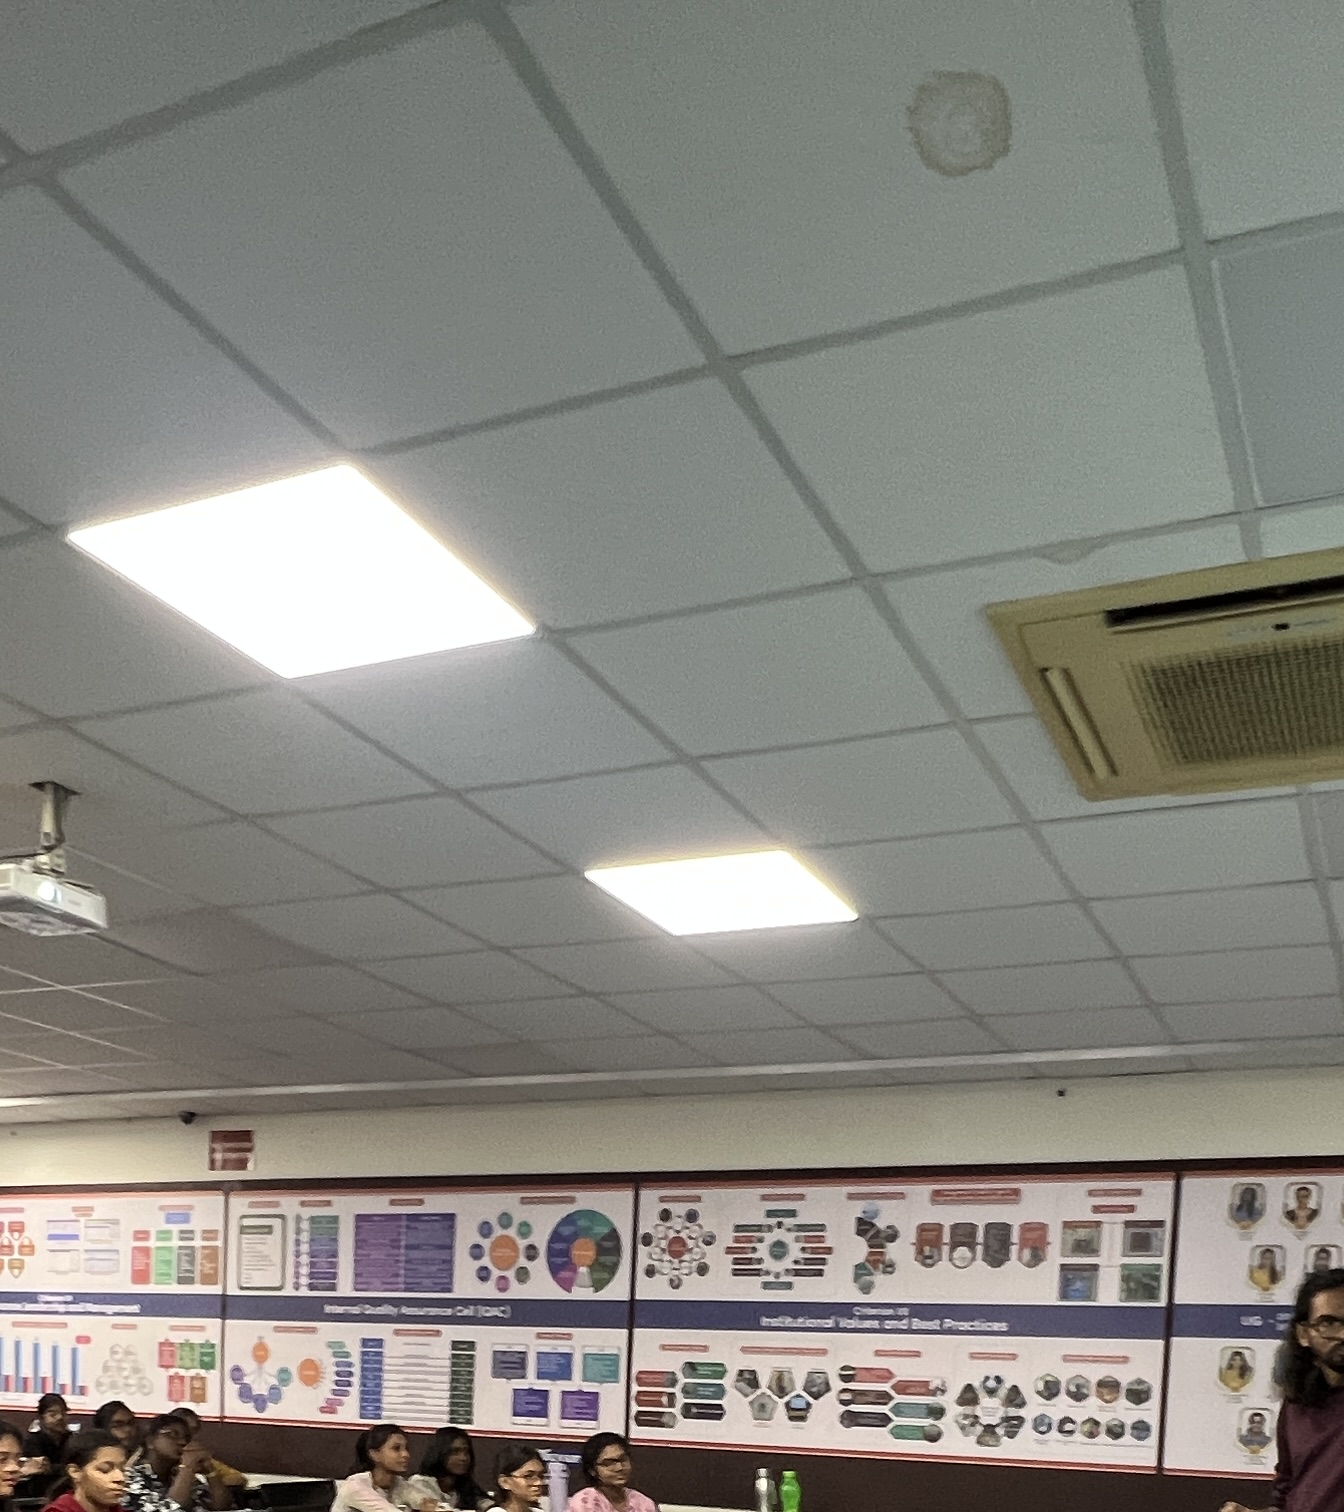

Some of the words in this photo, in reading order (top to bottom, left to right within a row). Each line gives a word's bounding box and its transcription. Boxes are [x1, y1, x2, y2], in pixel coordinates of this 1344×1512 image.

[760, 1316, 836, 1328] Institutional
[838, 1316, 880, 1329] Values
[883, 1318, 909, 1330] and
[911, 1318, 941, 1331] Best
[943, 1318, 1009, 1332] Practices
